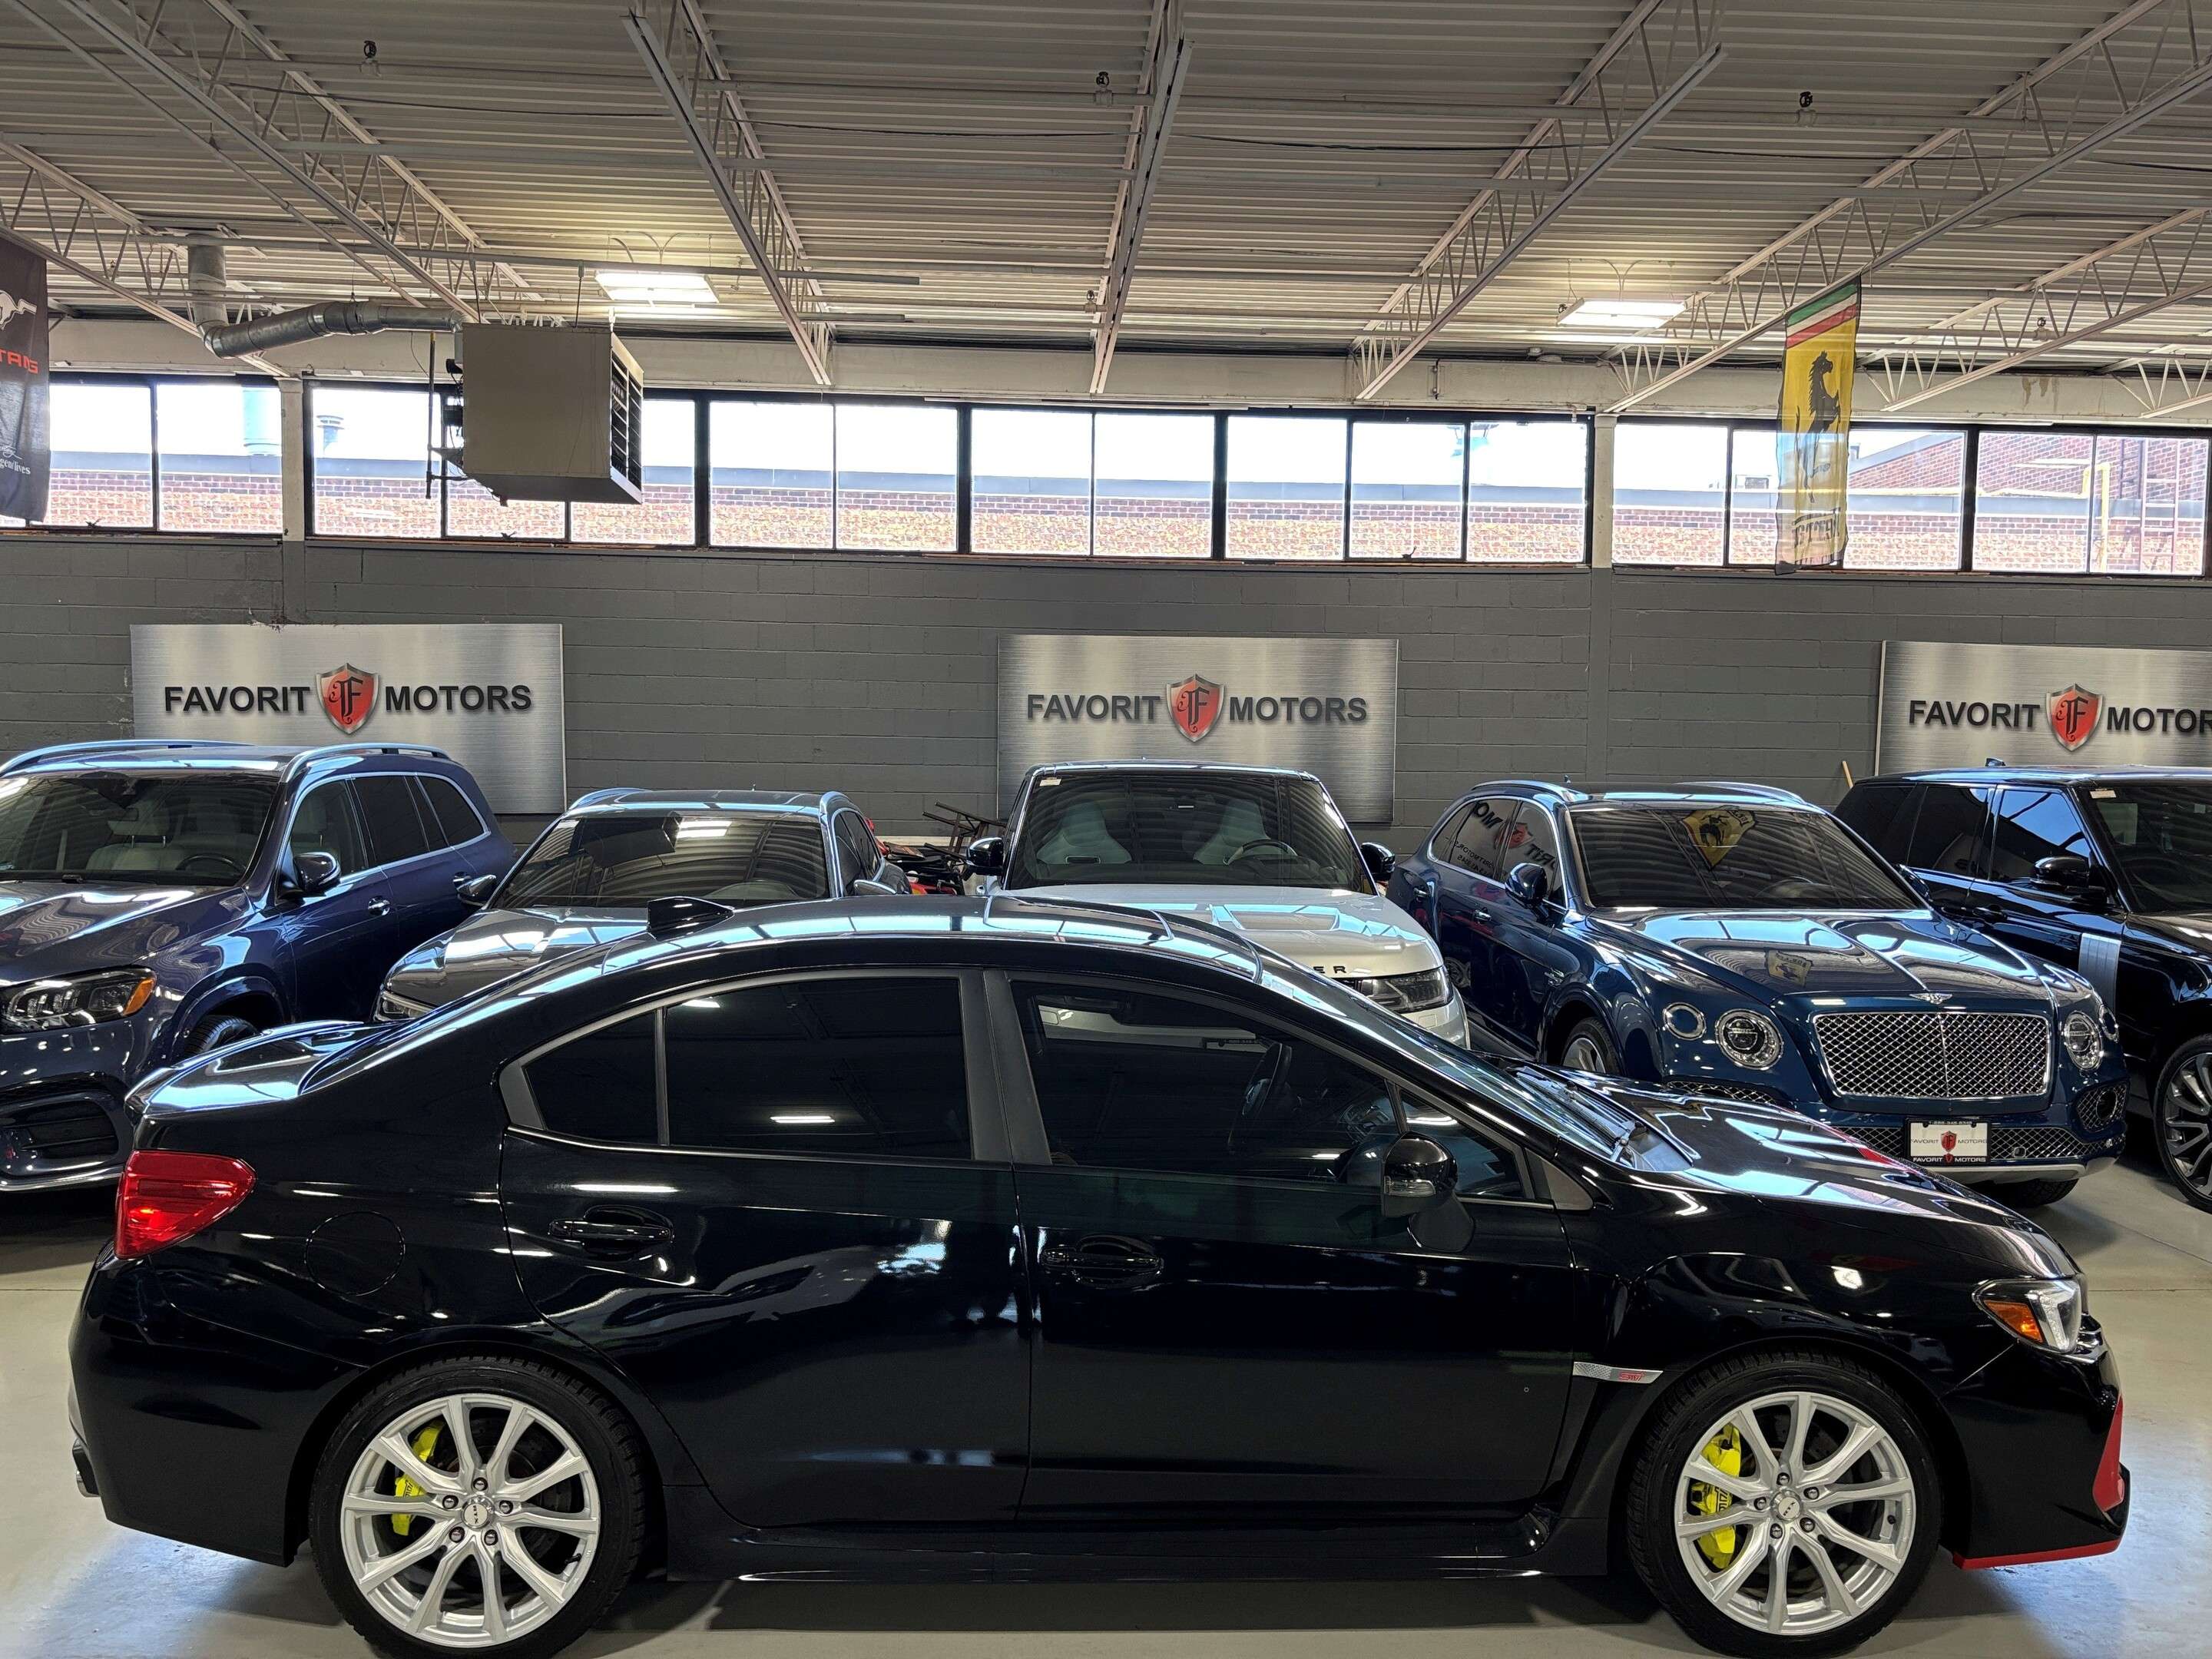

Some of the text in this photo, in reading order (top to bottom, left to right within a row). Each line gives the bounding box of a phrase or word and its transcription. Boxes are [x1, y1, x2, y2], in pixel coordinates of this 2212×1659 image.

[164, 686, 310, 711] FAVORIT
[386, 684, 531, 712] MOTORS
[1027, 694, 1160, 720] FAVORIT
[1230, 696, 1366, 721] MOTORS
[1909, 700, 2041, 728] FAVORIT
[2107, 707, 2212, 733] MOTOR
